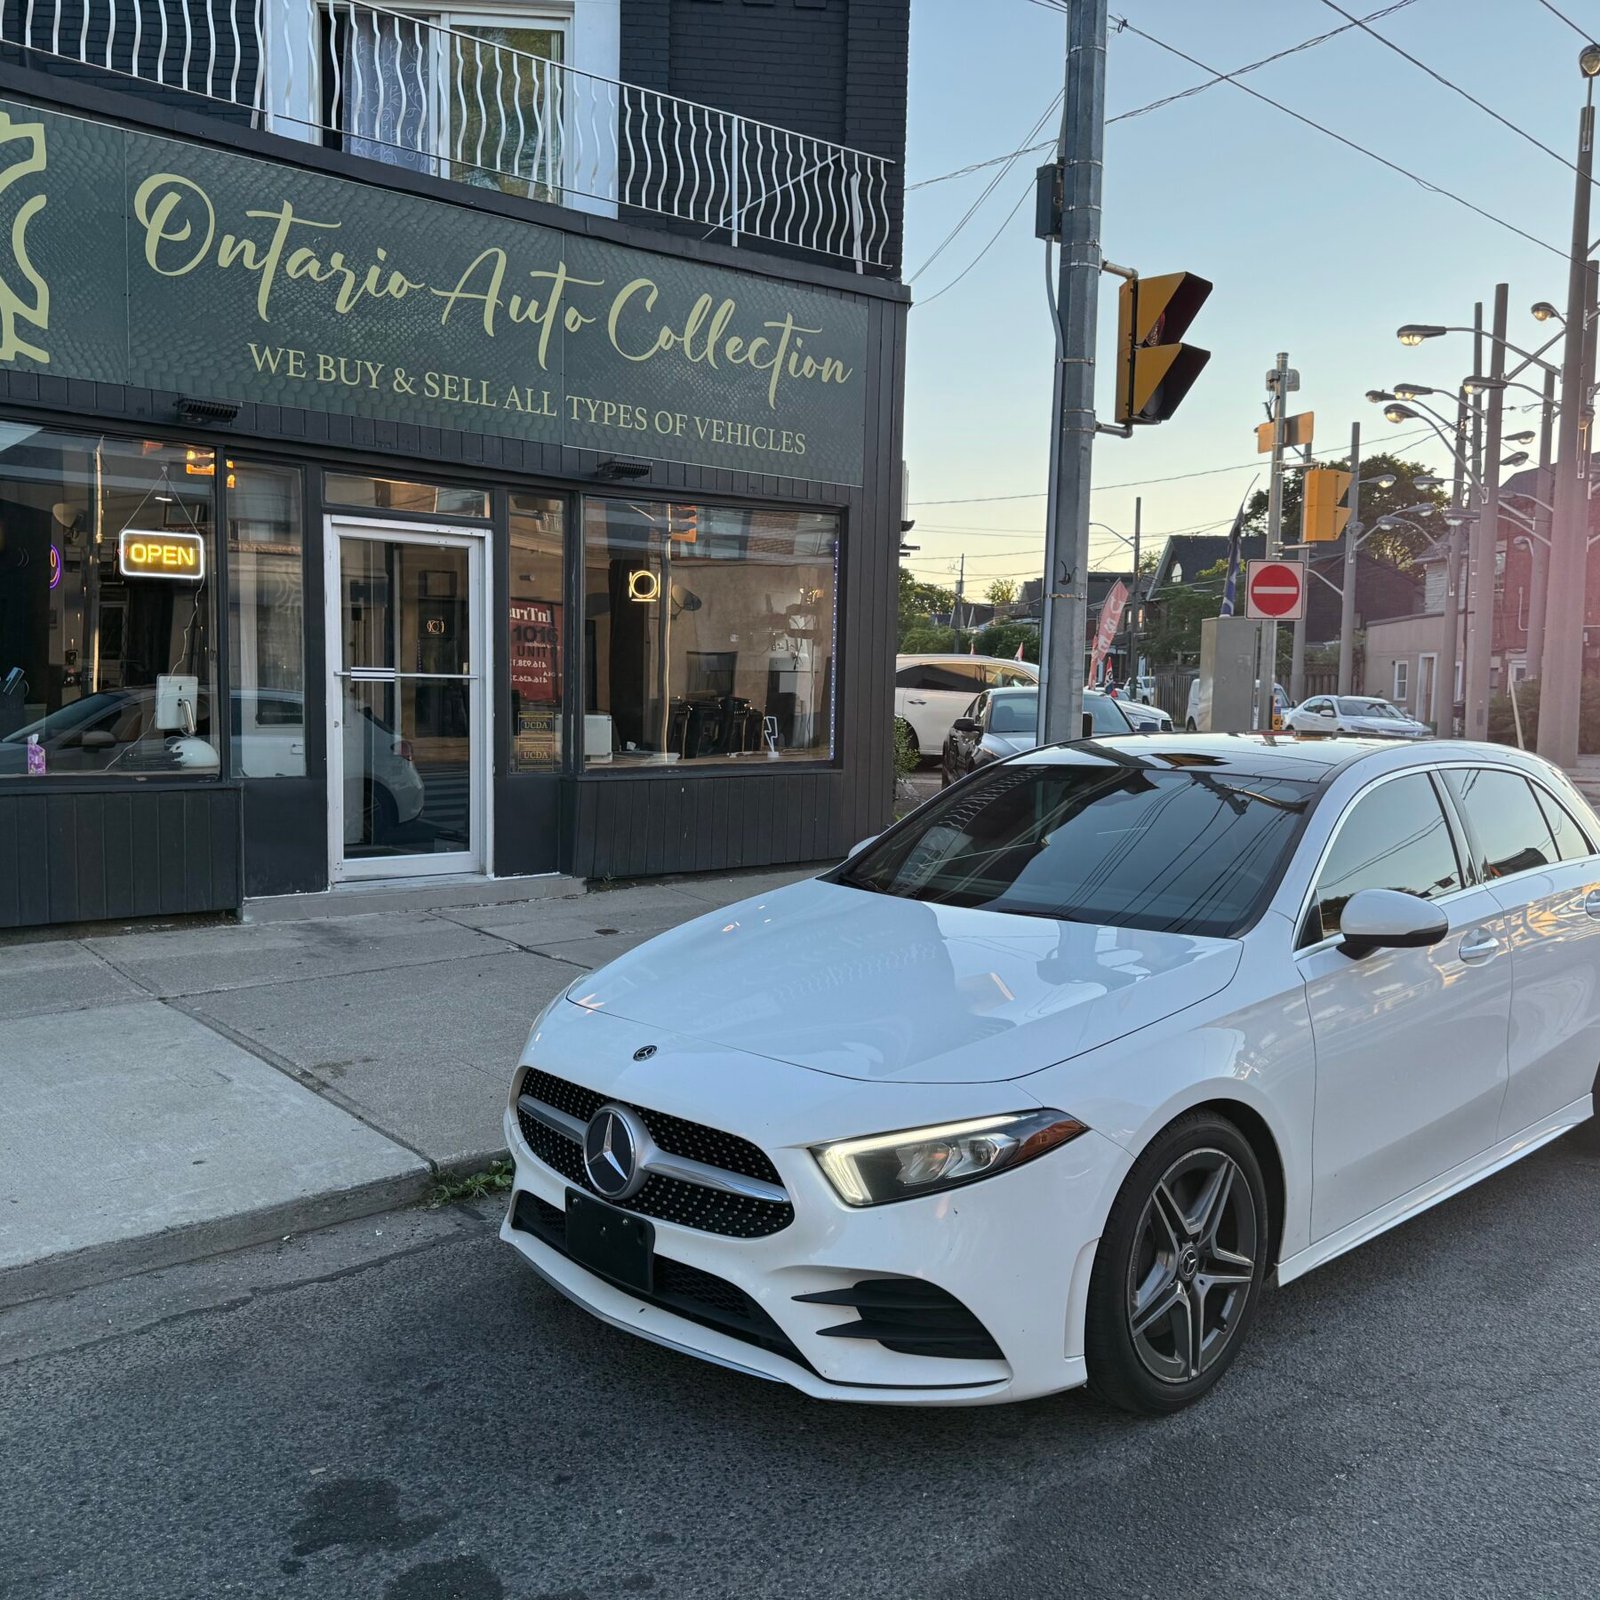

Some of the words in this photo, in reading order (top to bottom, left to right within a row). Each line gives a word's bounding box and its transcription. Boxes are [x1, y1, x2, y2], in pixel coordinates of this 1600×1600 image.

[133, 172, 425, 323] Ontario
[430, 246, 605, 371] Auto
[607, 277, 853, 410] Collection
[247, 342, 307, 379] WE
[316, 353, 385, 390] BUY
[392, 366, 417, 396] &
[424, 372, 497, 408] SELL
[503, 384, 558, 418] ALL
[564, 394, 648, 432] TYPES
[654, 409, 688, 437] OF
[693, 416, 806, 455] VEHICLES
[131, 543, 194, 566] OPEN
[516, 645, 547, 659] UNIT
